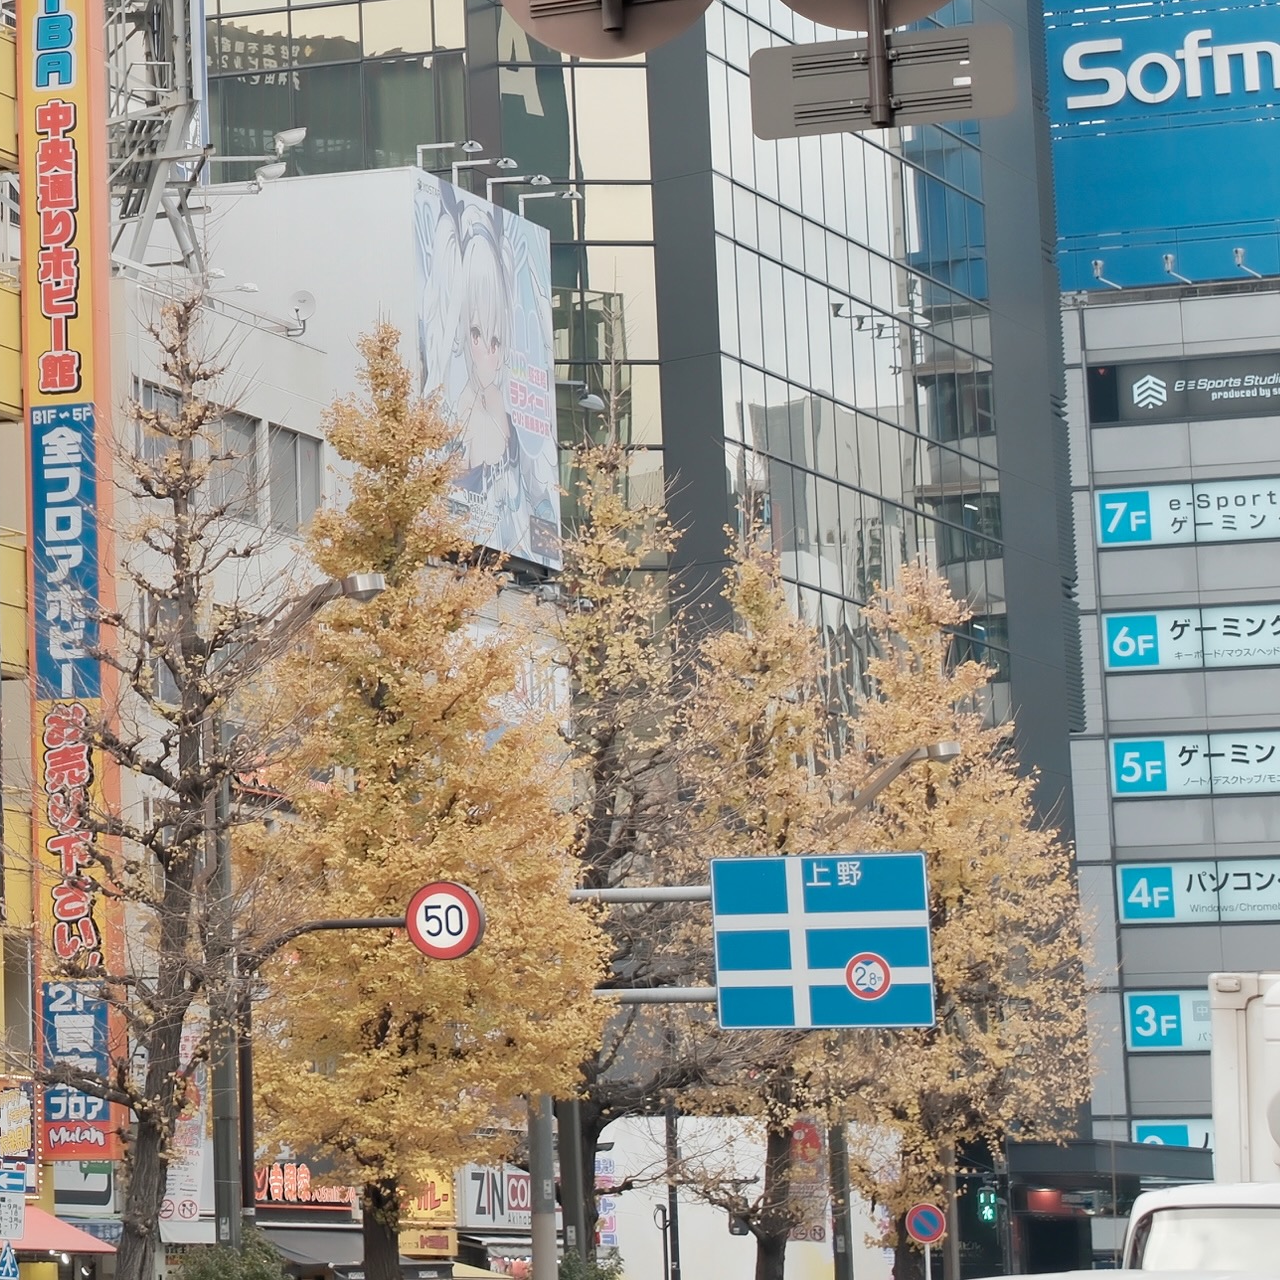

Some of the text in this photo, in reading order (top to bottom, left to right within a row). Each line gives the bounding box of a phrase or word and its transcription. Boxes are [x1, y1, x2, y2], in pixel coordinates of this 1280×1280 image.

[1211, 387, 1258, 401] produced
[1259, 387, 1271, 398] by
[1105, 503, 1146, 533] 7F
[1113, 626, 1154, 657] 6F
[1120, 751, 1162, 782] 5F
[806, 860, 863, 887] 上野
[1127, 877, 1170, 908] 4F
[423, 904, 464, 937] 50
[1135, 1004, 1177, 1037] 3F
[51, 1096, 104, 1120] フロア
[48, 1125, 106, 1148] Mulan
